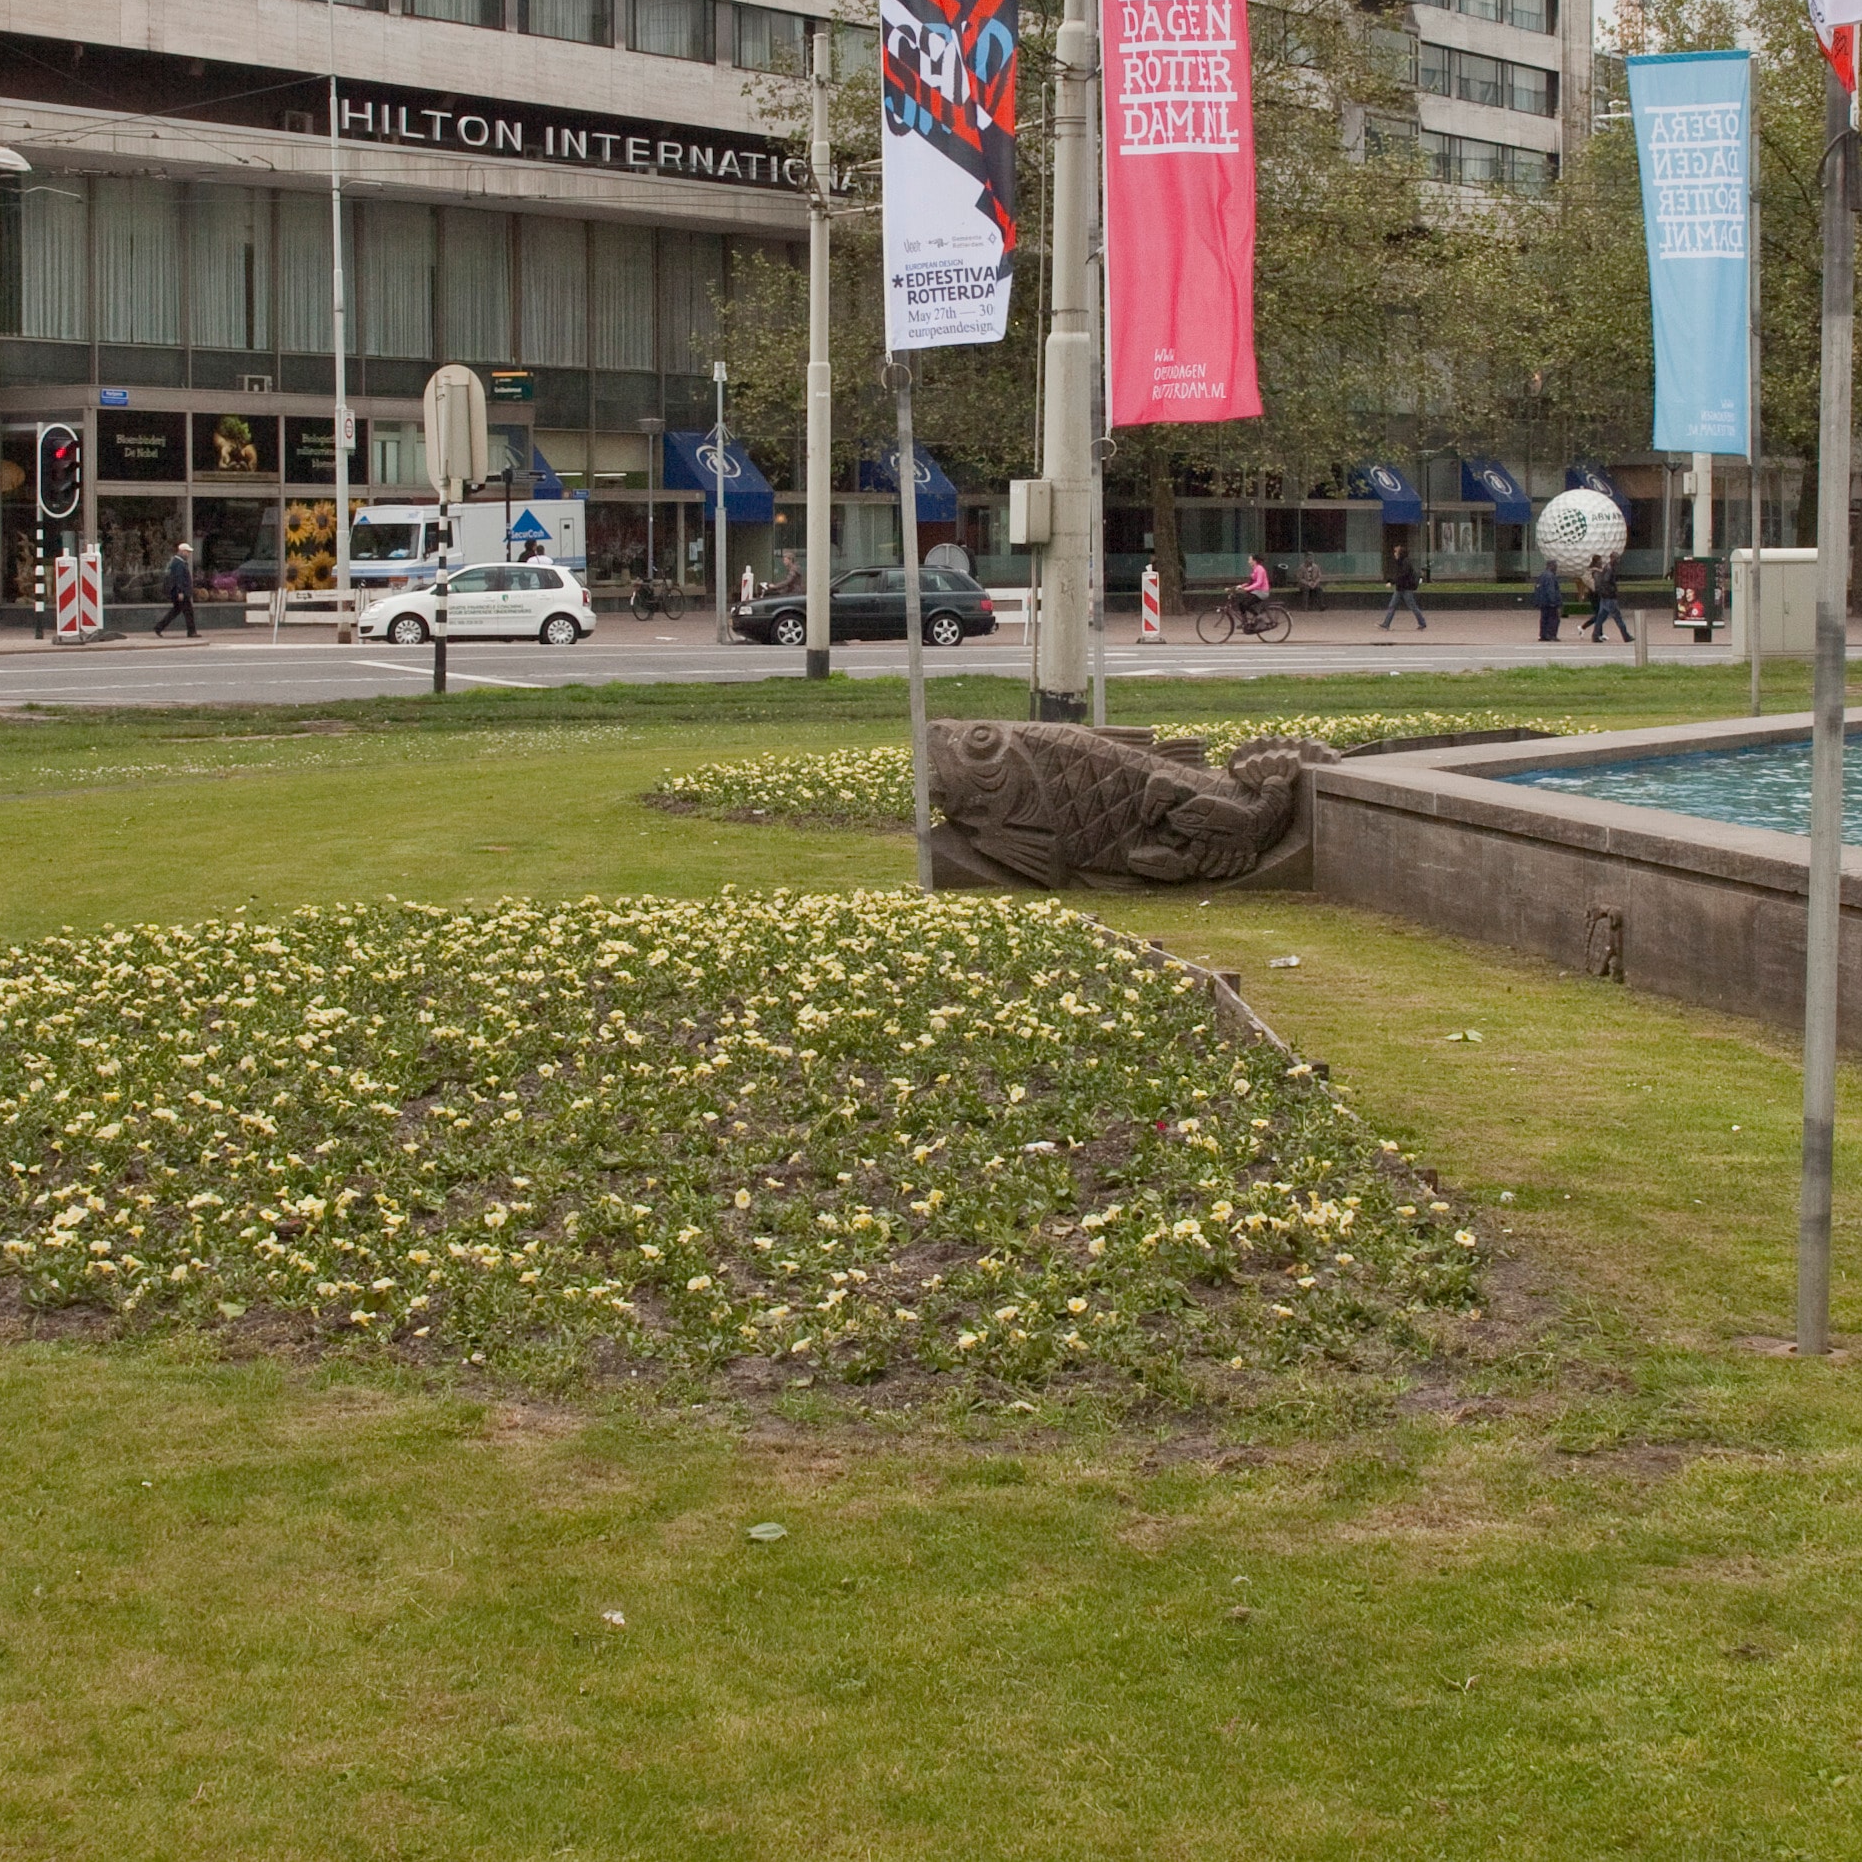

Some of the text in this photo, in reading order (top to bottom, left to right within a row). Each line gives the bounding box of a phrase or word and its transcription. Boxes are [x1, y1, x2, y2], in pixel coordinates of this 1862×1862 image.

[1122, 4, 1232, 37] DAGEN
[1123, 55, 1233, 88] ROTTER
[1123, 106, 1239, 144] DAM.NL
[341, 98, 876, 193] HILTON INTERNATIONA
[905, 258, 964, 272] EUROPEAN DESIGN
[908, 309, 931, 325] May
[934, 306, 957, 321] 27th
[978, 303, 994, 317] 30
[908, 321, 995, 340] europeandesign
